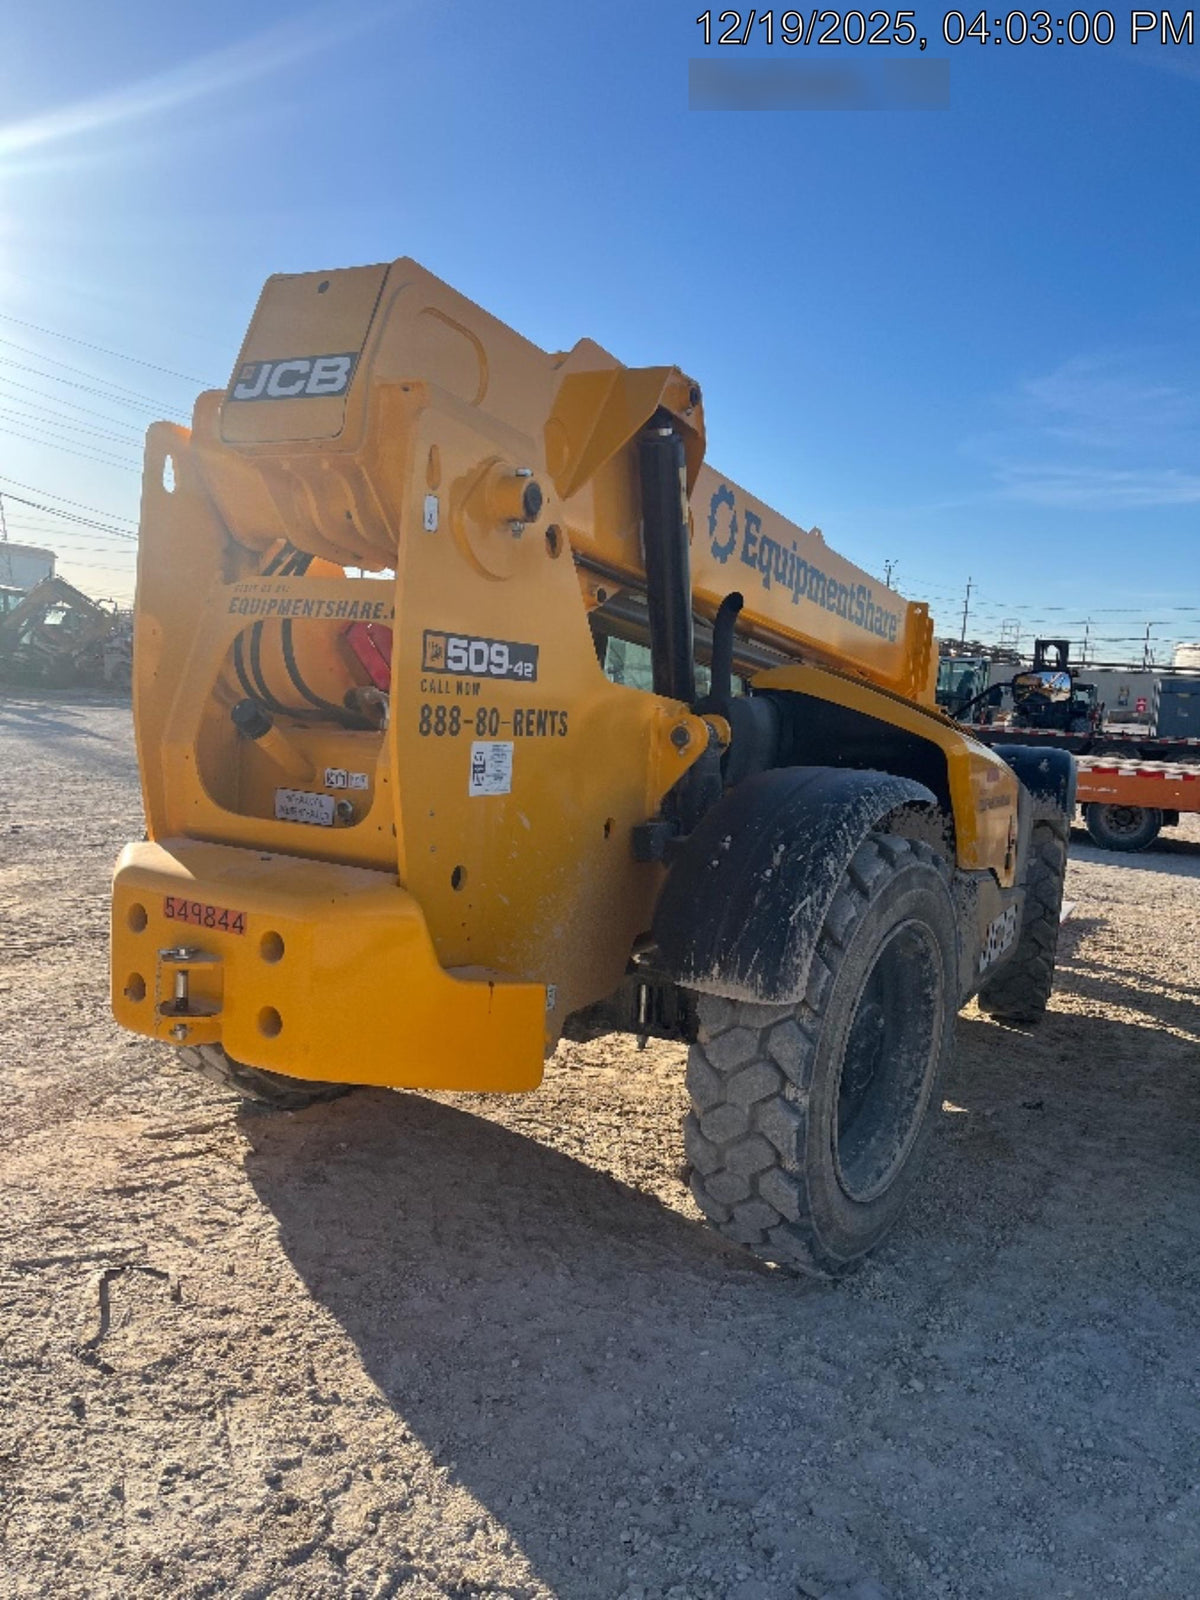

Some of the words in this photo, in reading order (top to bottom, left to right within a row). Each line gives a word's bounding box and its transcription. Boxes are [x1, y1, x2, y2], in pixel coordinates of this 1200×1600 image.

[233, 356, 351, 400] JCB
[740, 509, 898, 643] EquipmentShare
[420, 679, 450, 694] CALL
[456, 680, 481, 696] NOW
[418, 703, 569, 737] 888-80-RENTS
[164, 896, 244, 935] 549844
